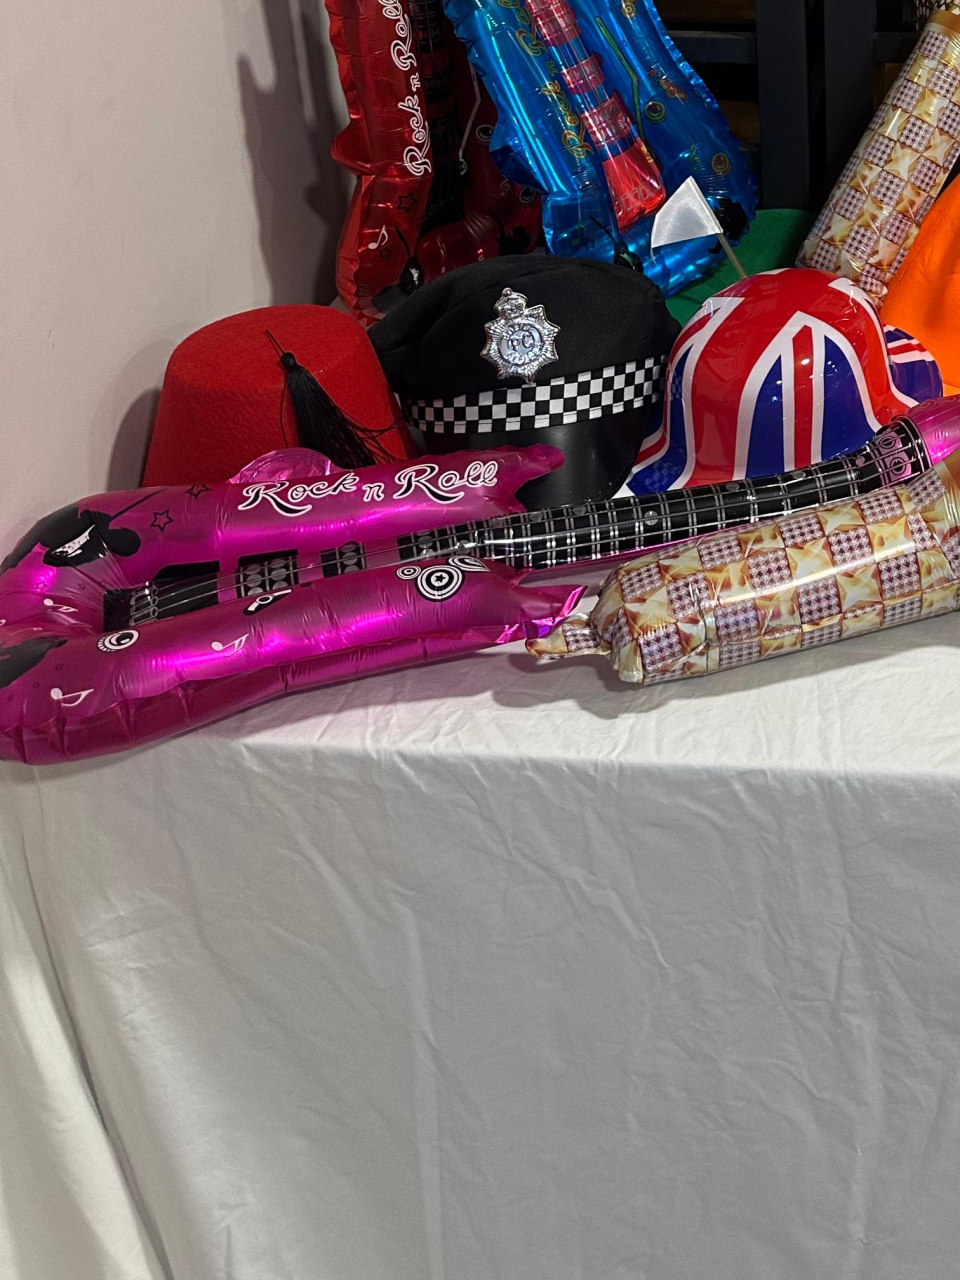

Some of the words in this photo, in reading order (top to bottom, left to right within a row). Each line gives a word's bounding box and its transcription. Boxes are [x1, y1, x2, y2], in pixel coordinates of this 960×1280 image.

[410, 72, 421, 92] n
[398, 94, 432, 176] Rock
[541, 80, 595, 159] Rock
[238, 471, 359, 517] Rock
[362, 483, 385, 502] n
[393, 461, 499, 504] Roll
